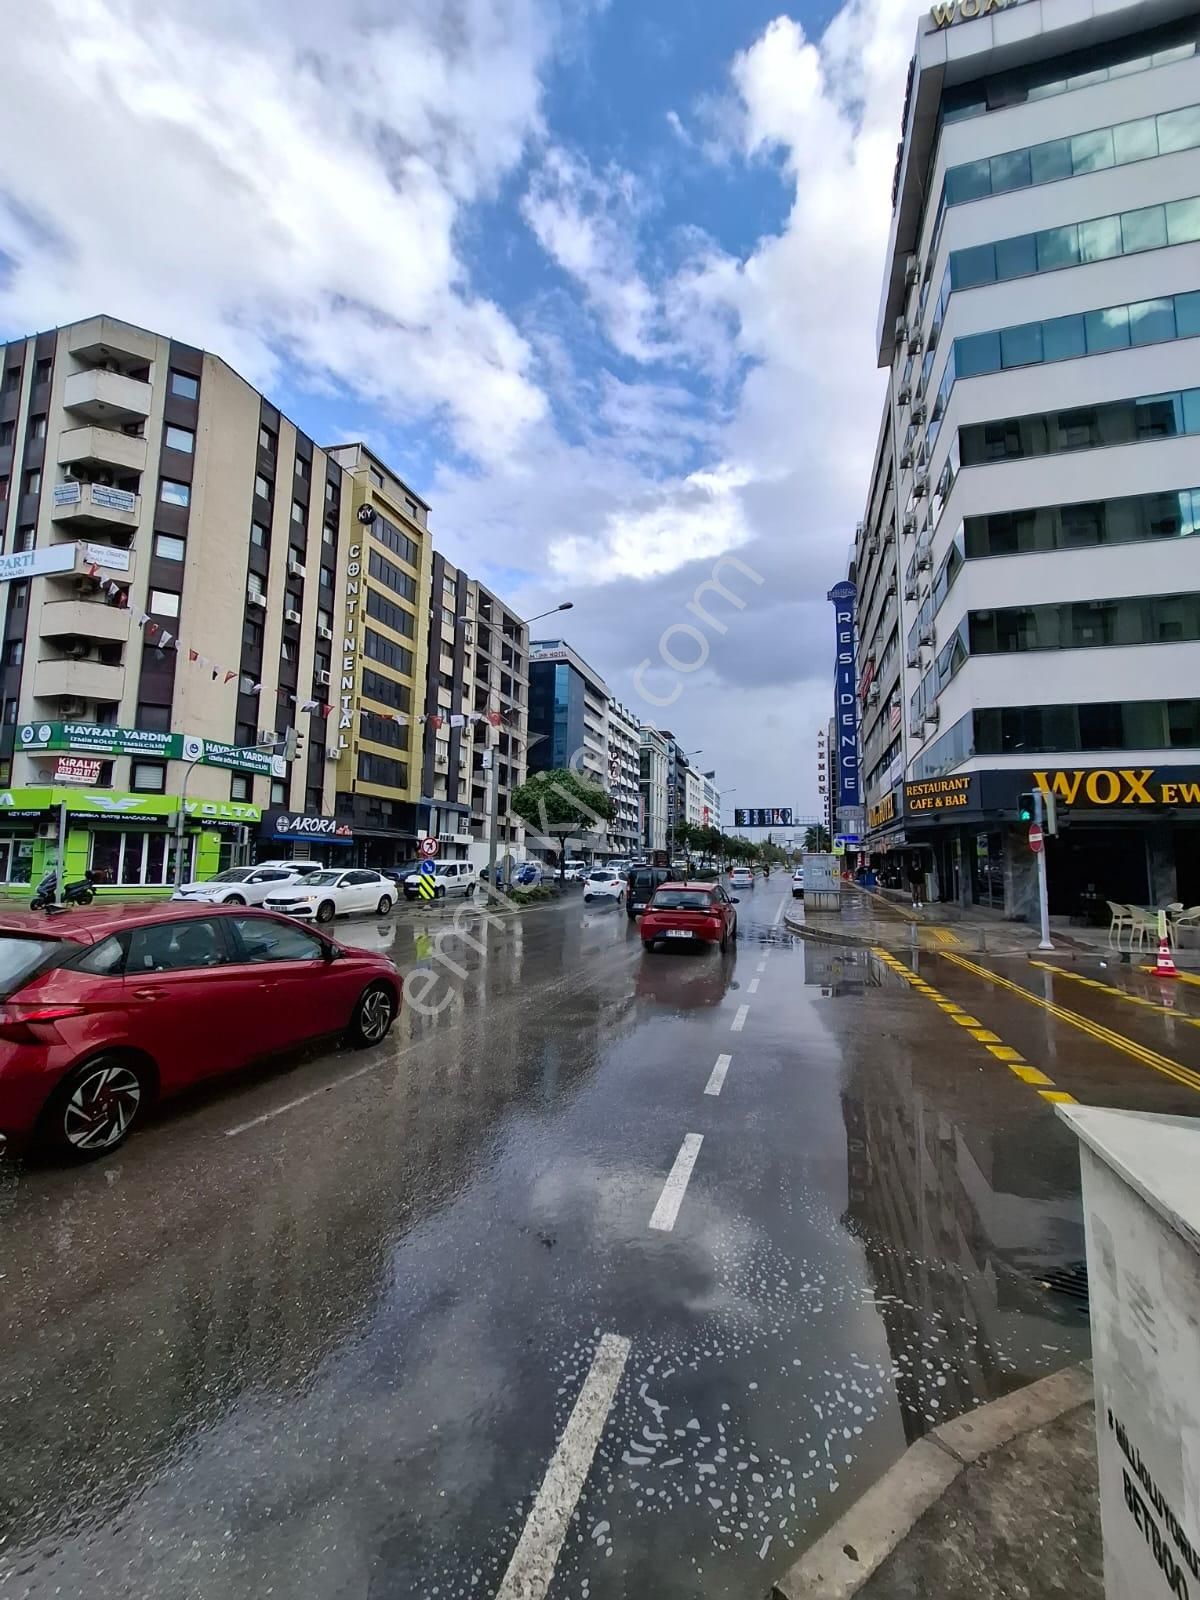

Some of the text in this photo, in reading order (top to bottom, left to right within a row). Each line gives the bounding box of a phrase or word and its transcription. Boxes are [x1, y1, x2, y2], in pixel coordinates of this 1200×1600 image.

[339, 544, 361, 749] CONTINENTAL
[837, 611, 856, 789] RESIDENCE
[64, 725, 173, 743] HAYRAT YARDIM
[206, 743, 272, 764] HAYRAT YARDIM
[817, 730, 826, 794] ANEMON
[906, 777, 970, 796] RESTAURANT
[1032, 770, 1156, 804] WOX
[184, 800, 259, 819] VOLTA
[910, 793, 968, 810] CAFE & BAR
[290, 816, 337, 834] ARORA
